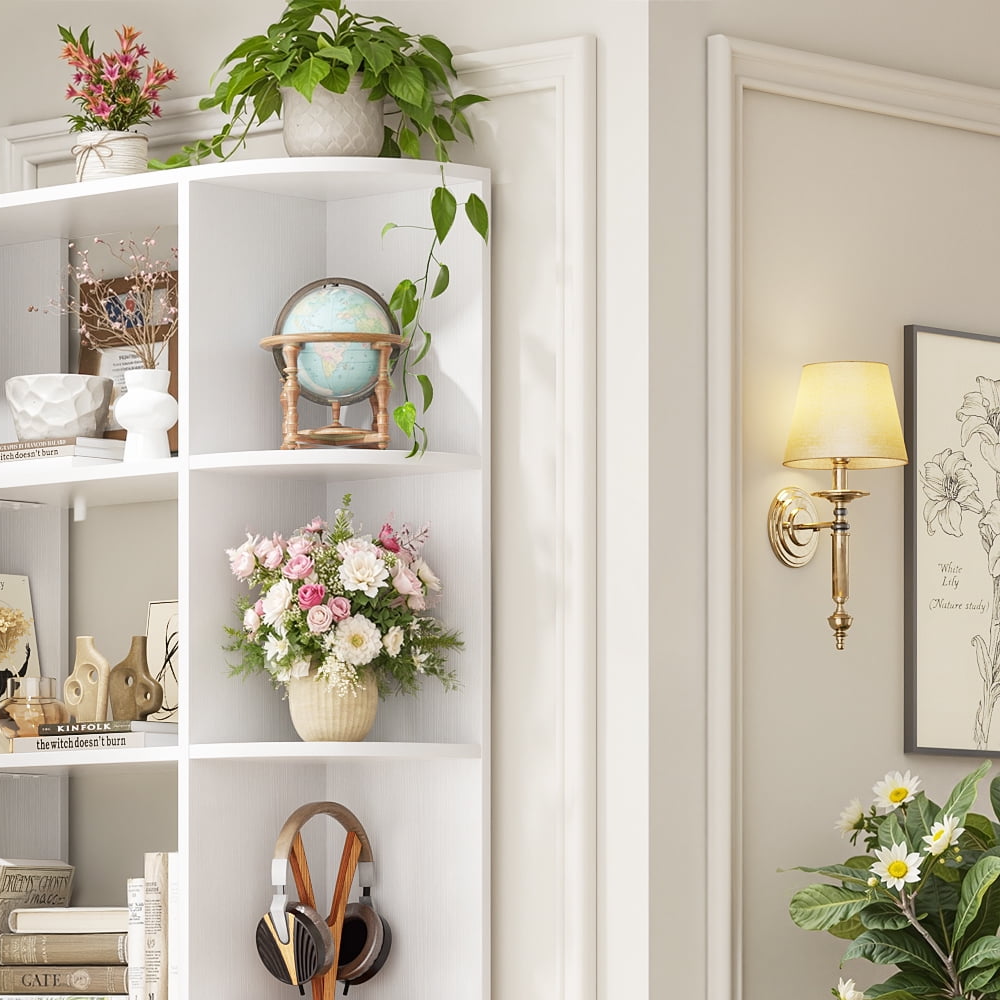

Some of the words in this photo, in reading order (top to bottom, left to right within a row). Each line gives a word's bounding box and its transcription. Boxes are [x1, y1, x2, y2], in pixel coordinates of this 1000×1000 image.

[15, 449, 40, 459] doesn't
[41, 449, 59, 457] burn
[942, 575, 960, 590] Lily
[57, 722, 111, 733] KINFOLK
[36, 739, 50, 750] the
[51, 737, 74, 749] witch
[74, 736, 105, 748] doesn't
[106, 736, 126, 746] burn
[21, 973, 61, 987] GATE
